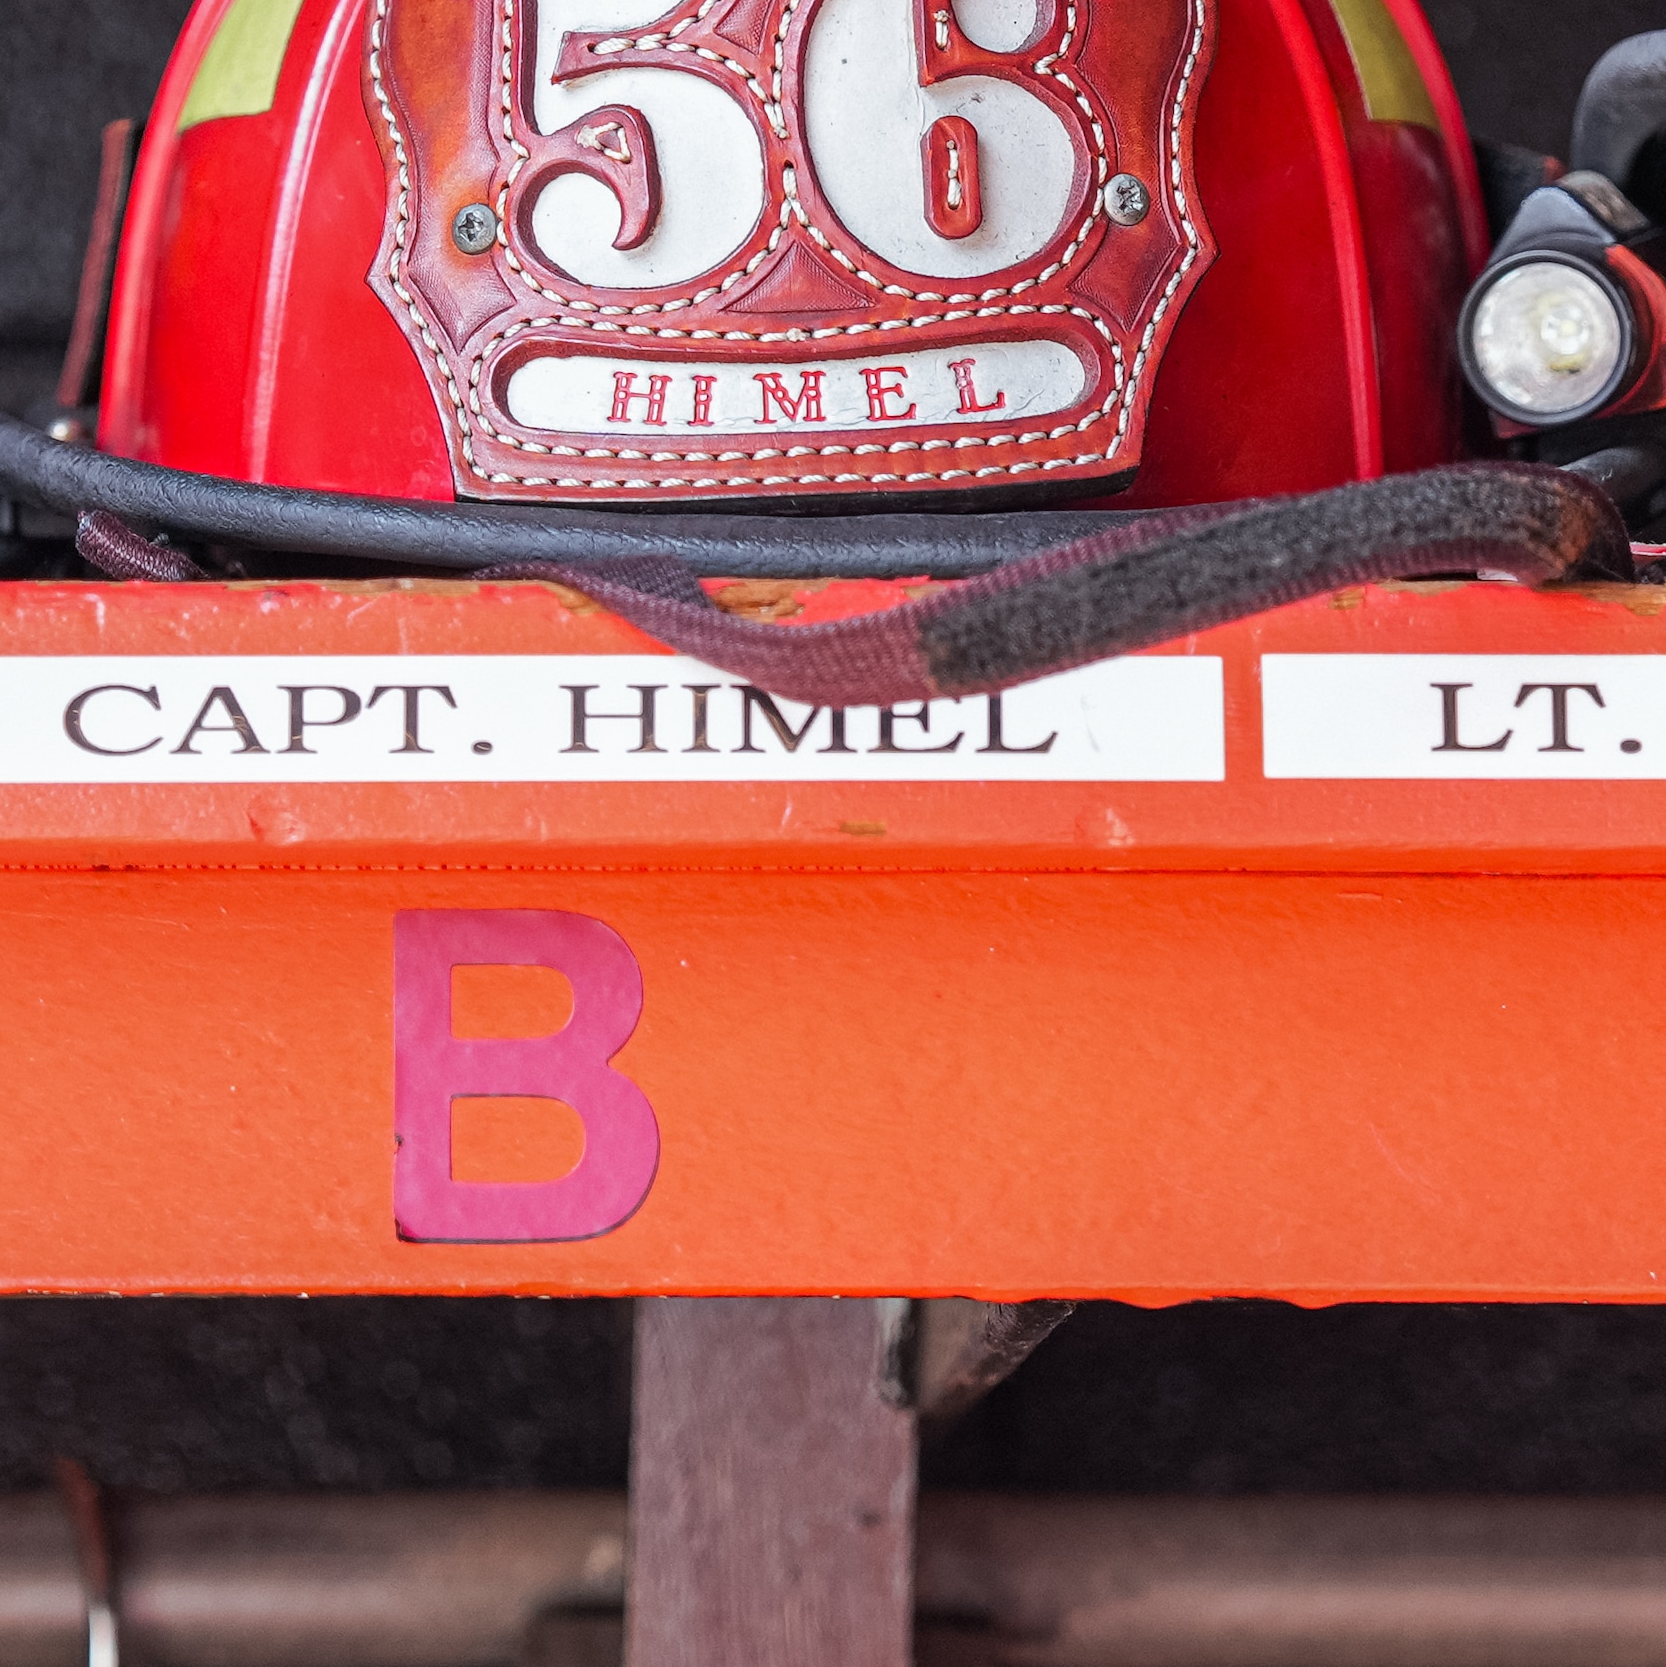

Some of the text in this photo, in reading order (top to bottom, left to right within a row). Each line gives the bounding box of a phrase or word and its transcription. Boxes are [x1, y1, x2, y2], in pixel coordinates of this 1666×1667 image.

[606, 357, 1006, 427] HIMEL
[62, 683, 1059, 756] CAPT. HIMEL
[1428, 681, 1643, 757] LT.
[393, 908, 661, 1243] B
